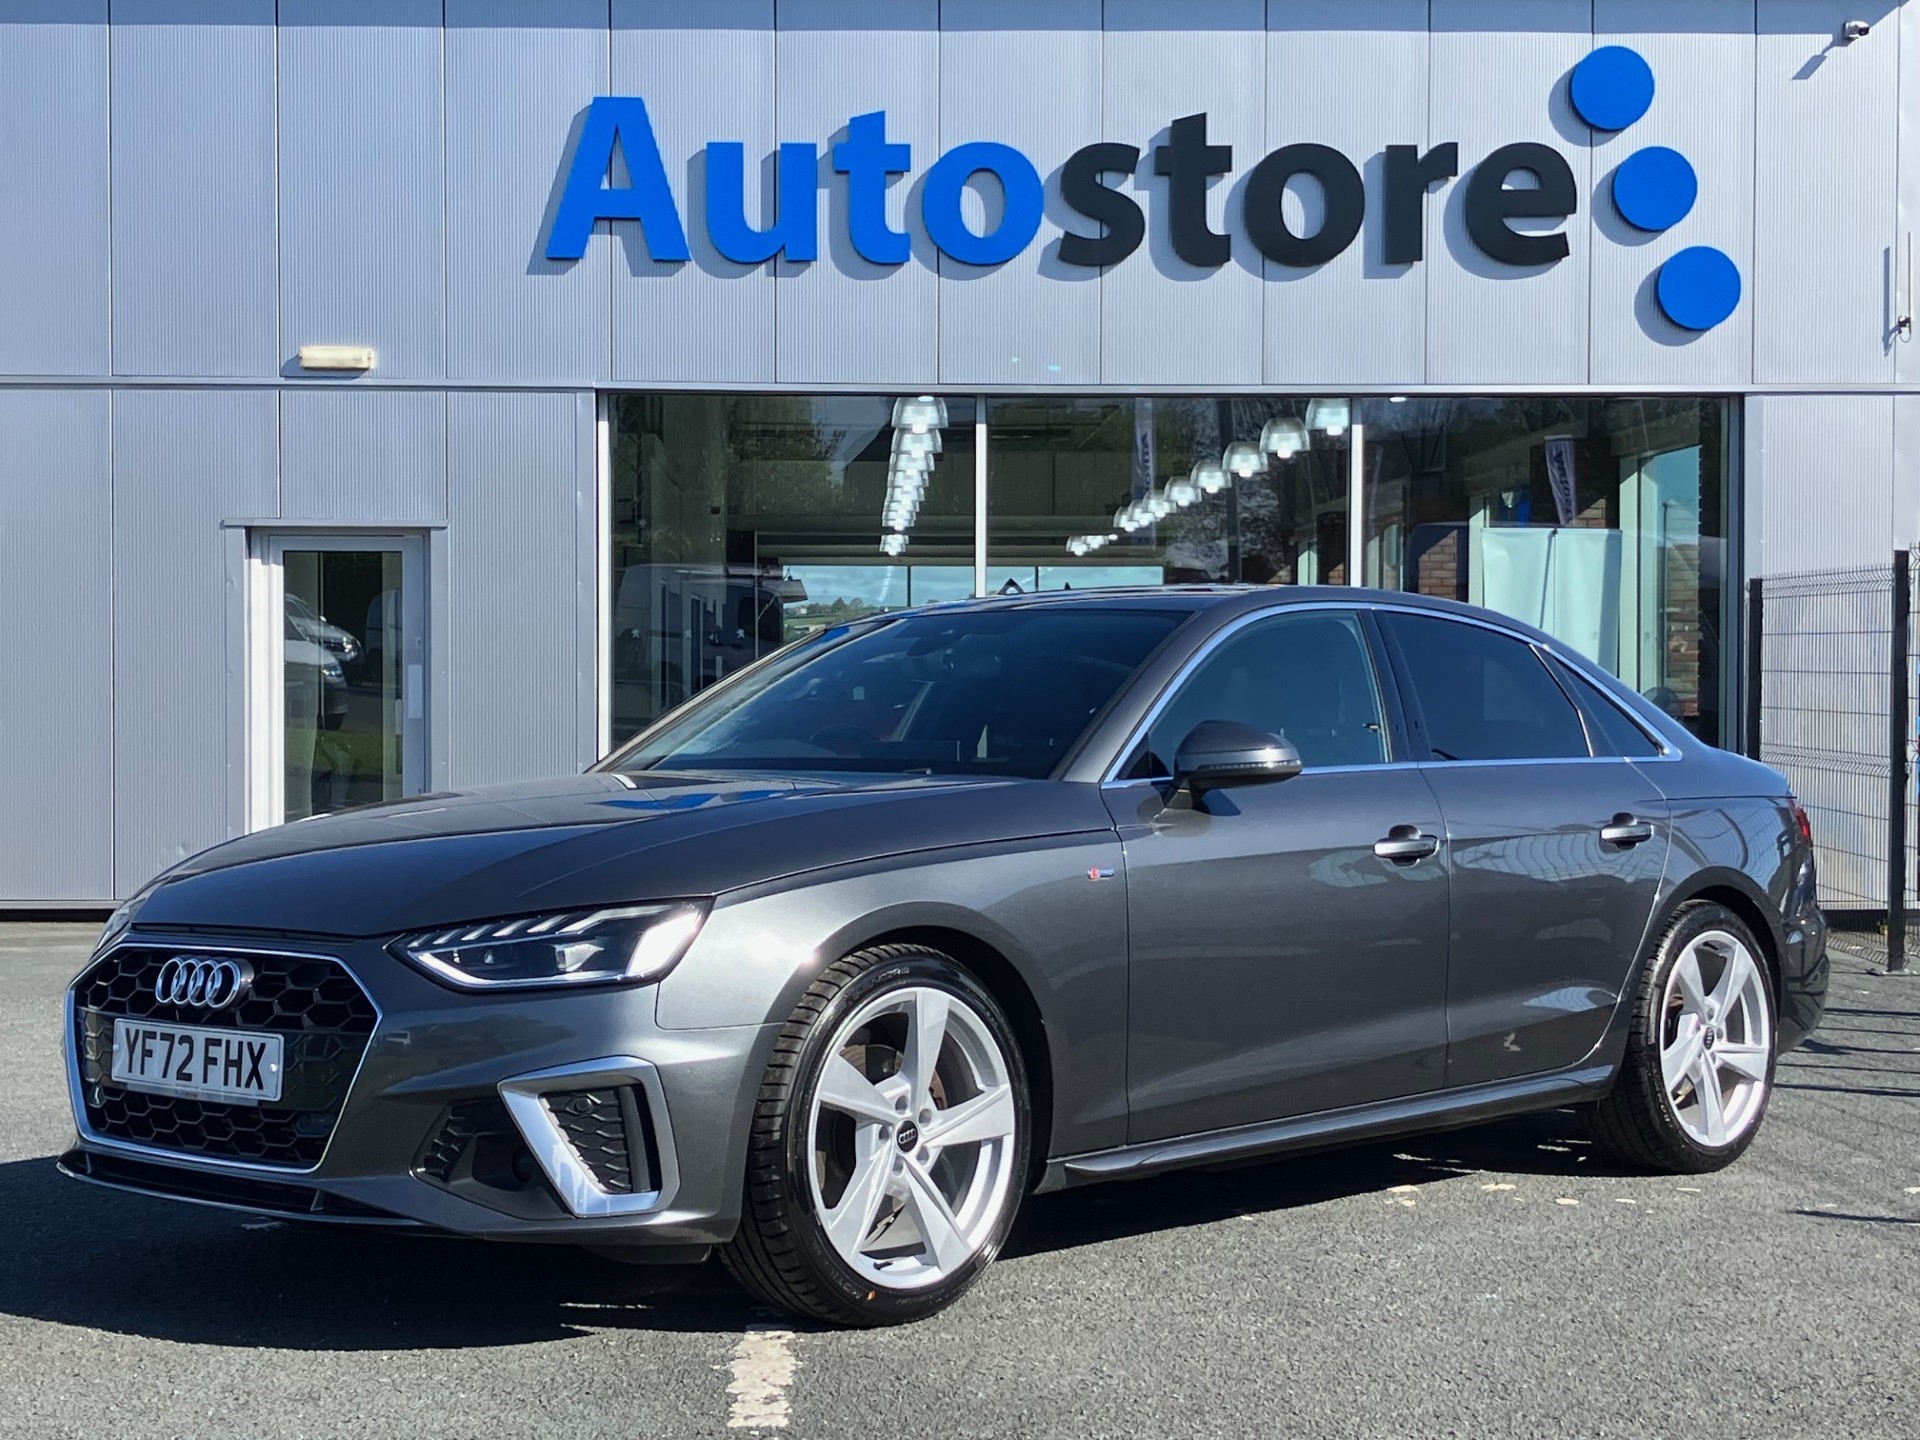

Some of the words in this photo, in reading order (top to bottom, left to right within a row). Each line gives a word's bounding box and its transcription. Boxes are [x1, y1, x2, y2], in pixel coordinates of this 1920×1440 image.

[546, 96, 1577, 266] Autostore
[125, 1027, 195, 1082] YF72
[202, 1037, 266, 1091] FHX
